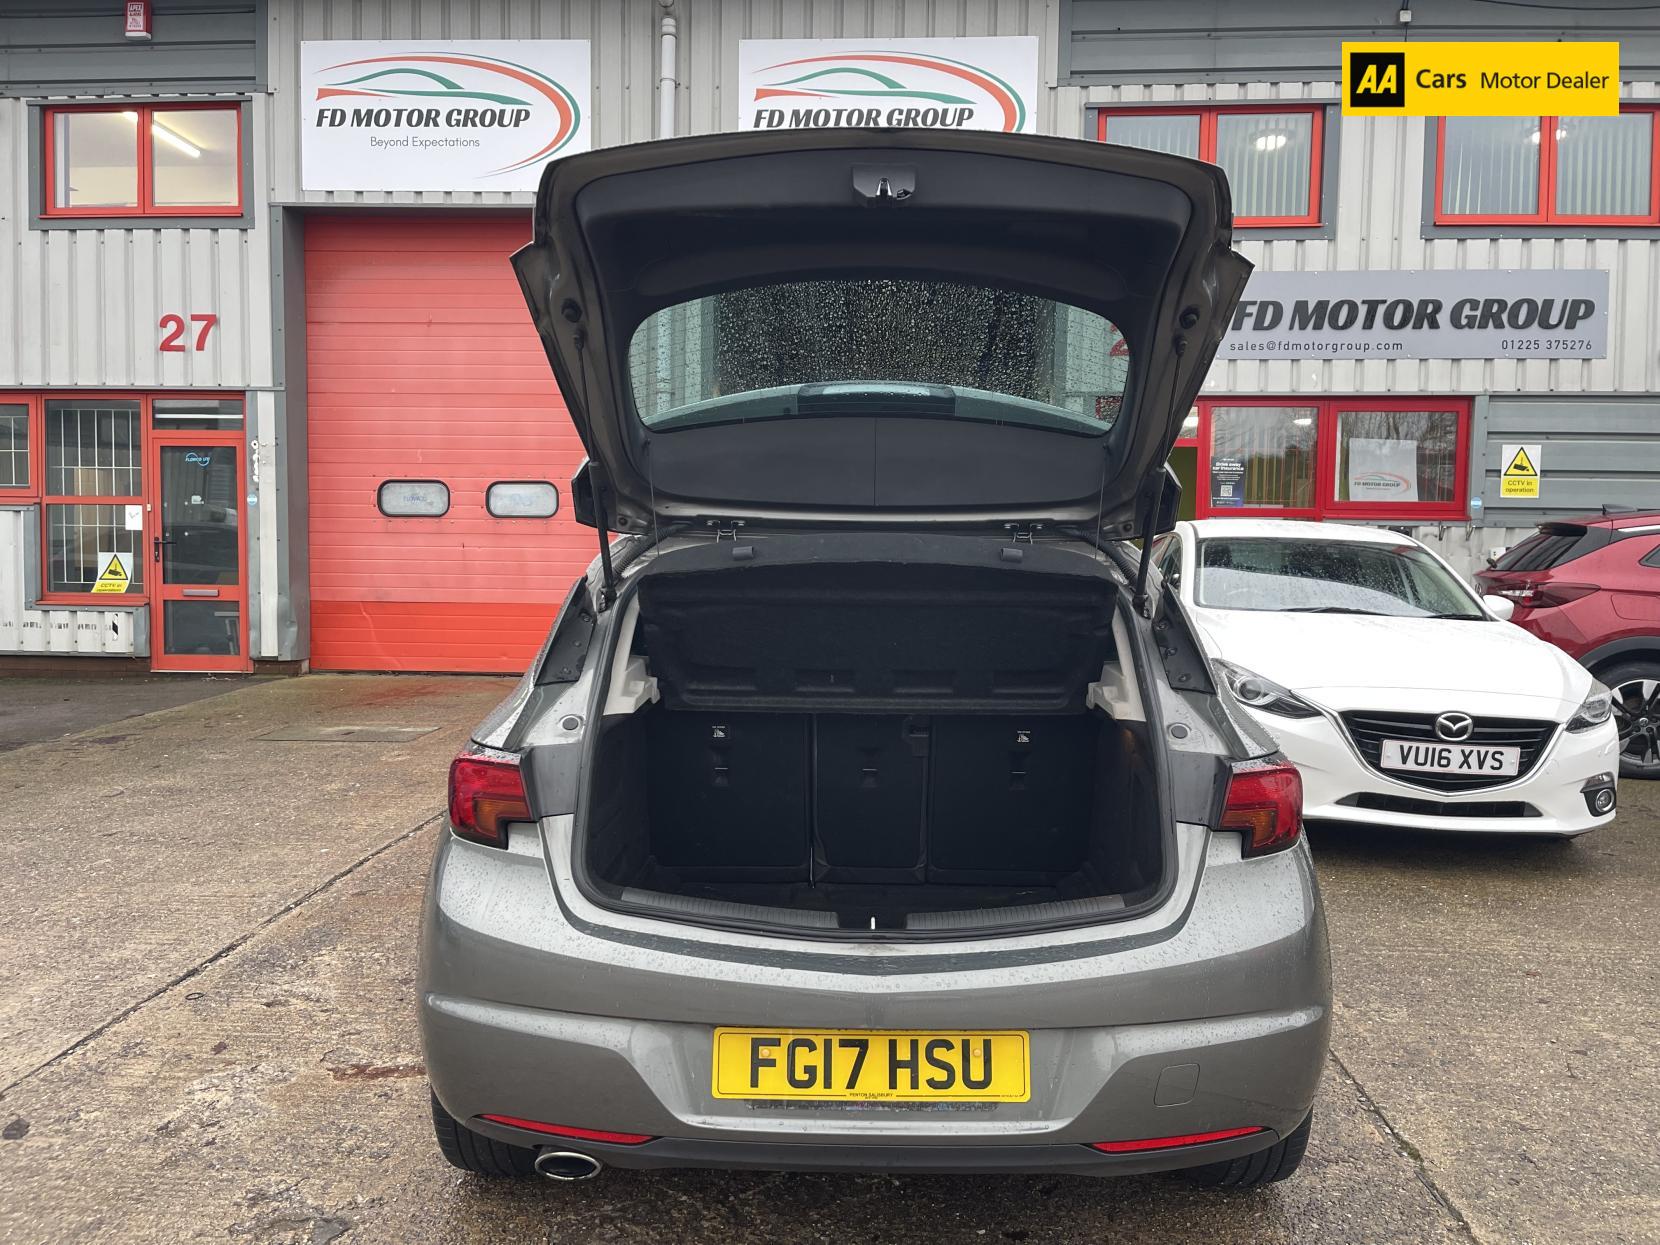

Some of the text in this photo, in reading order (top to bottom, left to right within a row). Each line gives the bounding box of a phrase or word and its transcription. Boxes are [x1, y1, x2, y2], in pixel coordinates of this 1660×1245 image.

[316, 108, 530, 128] FD MOTOR GROUP
[753, 107, 975, 129] FD MOTOR GROUP
[370, 136, 481, 150] Beyond Expectations
[1231, 297, 1596, 331] FD MOTOR GROUP
[159, 314, 218, 353] 27
[1230, 340, 1403, 353] sales@fdmotorgroup.com
[1501, 339, 1593, 351] 01225 375276
[1399, 744, 1505, 771] VU16 XVS
[750, 1037, 993, 1090] FG17 HSU
